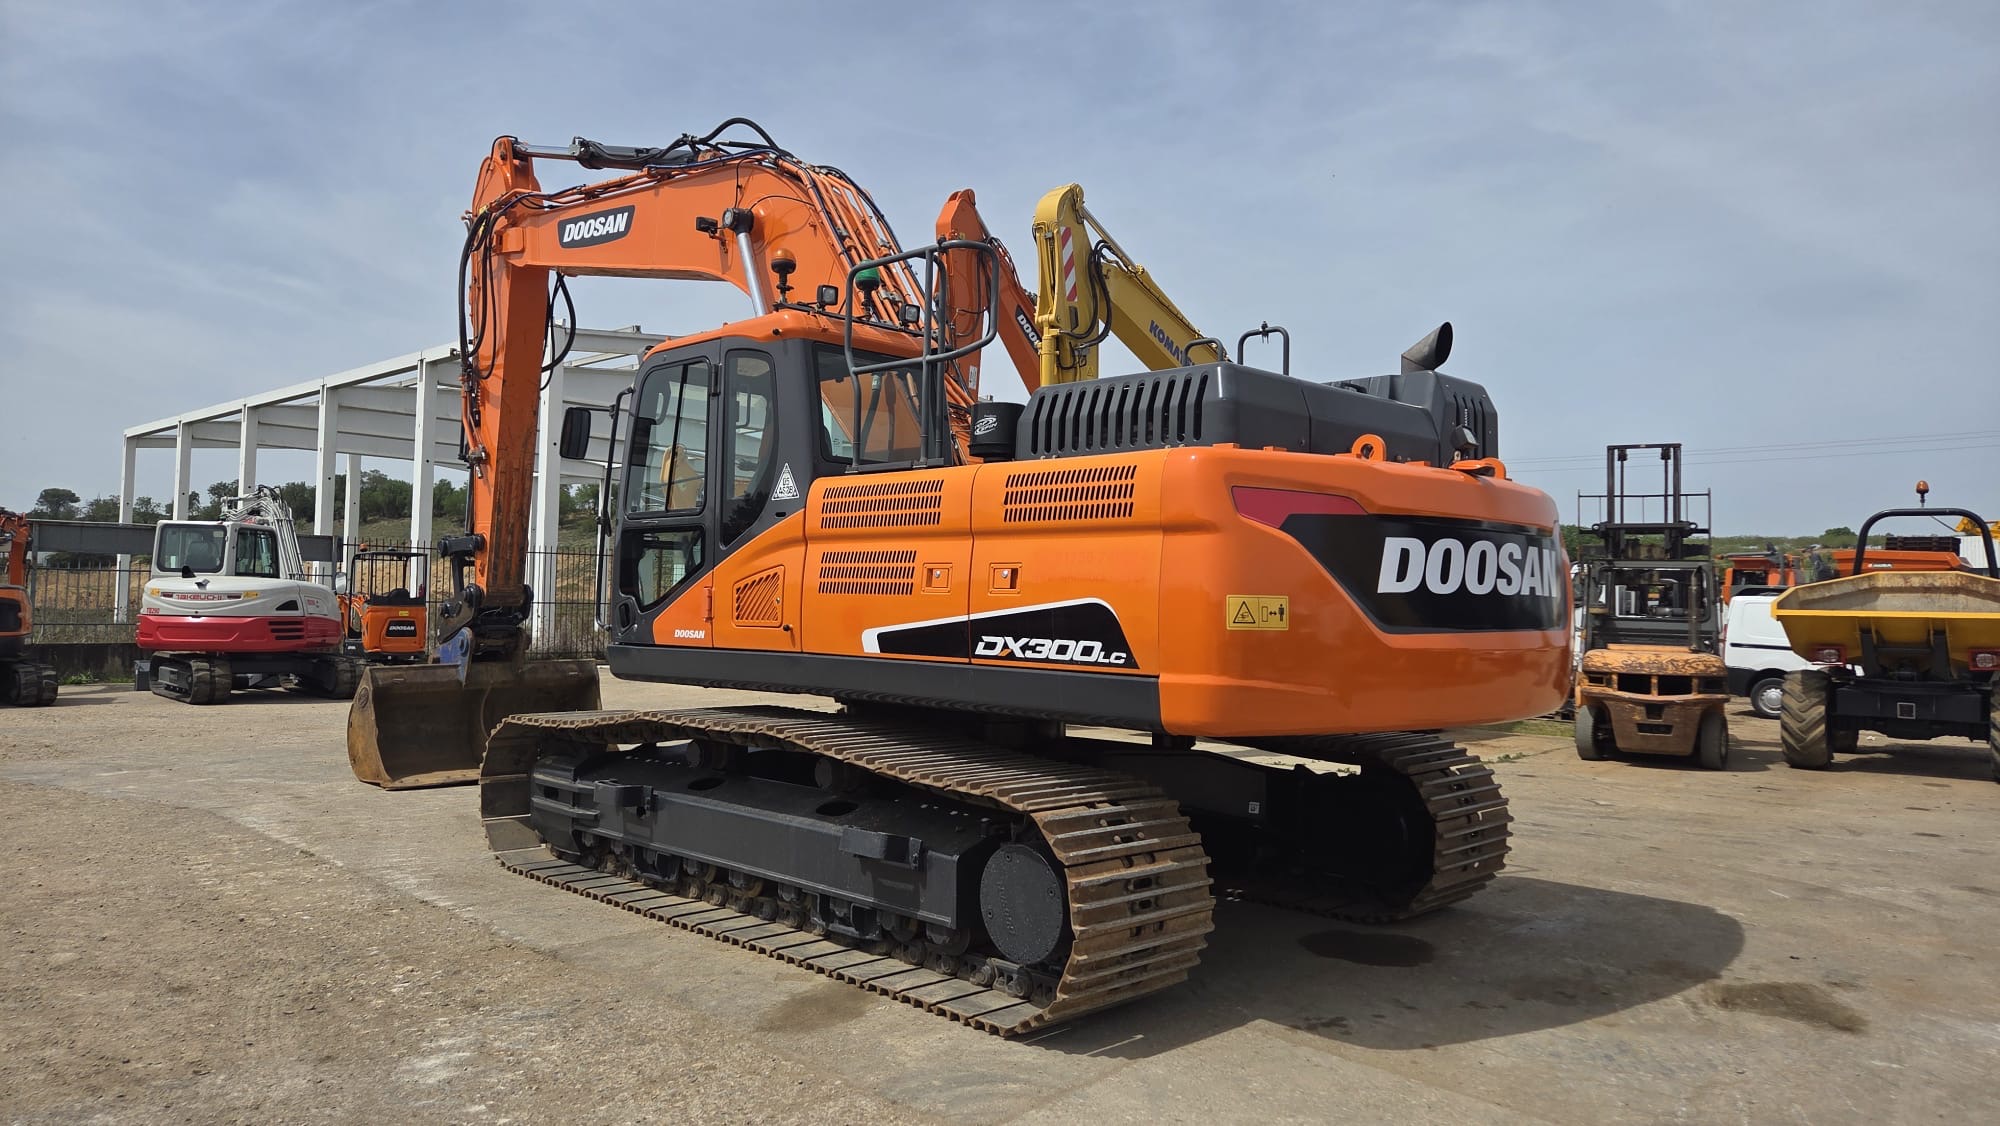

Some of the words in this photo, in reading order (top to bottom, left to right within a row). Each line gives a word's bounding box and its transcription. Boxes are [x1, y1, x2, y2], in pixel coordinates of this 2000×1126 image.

[562, 212, 629, 243] DOOSAN
[1377, 537, 1557, 597] DOOSAN
[674, 629, 705, 639] DOOSAN
